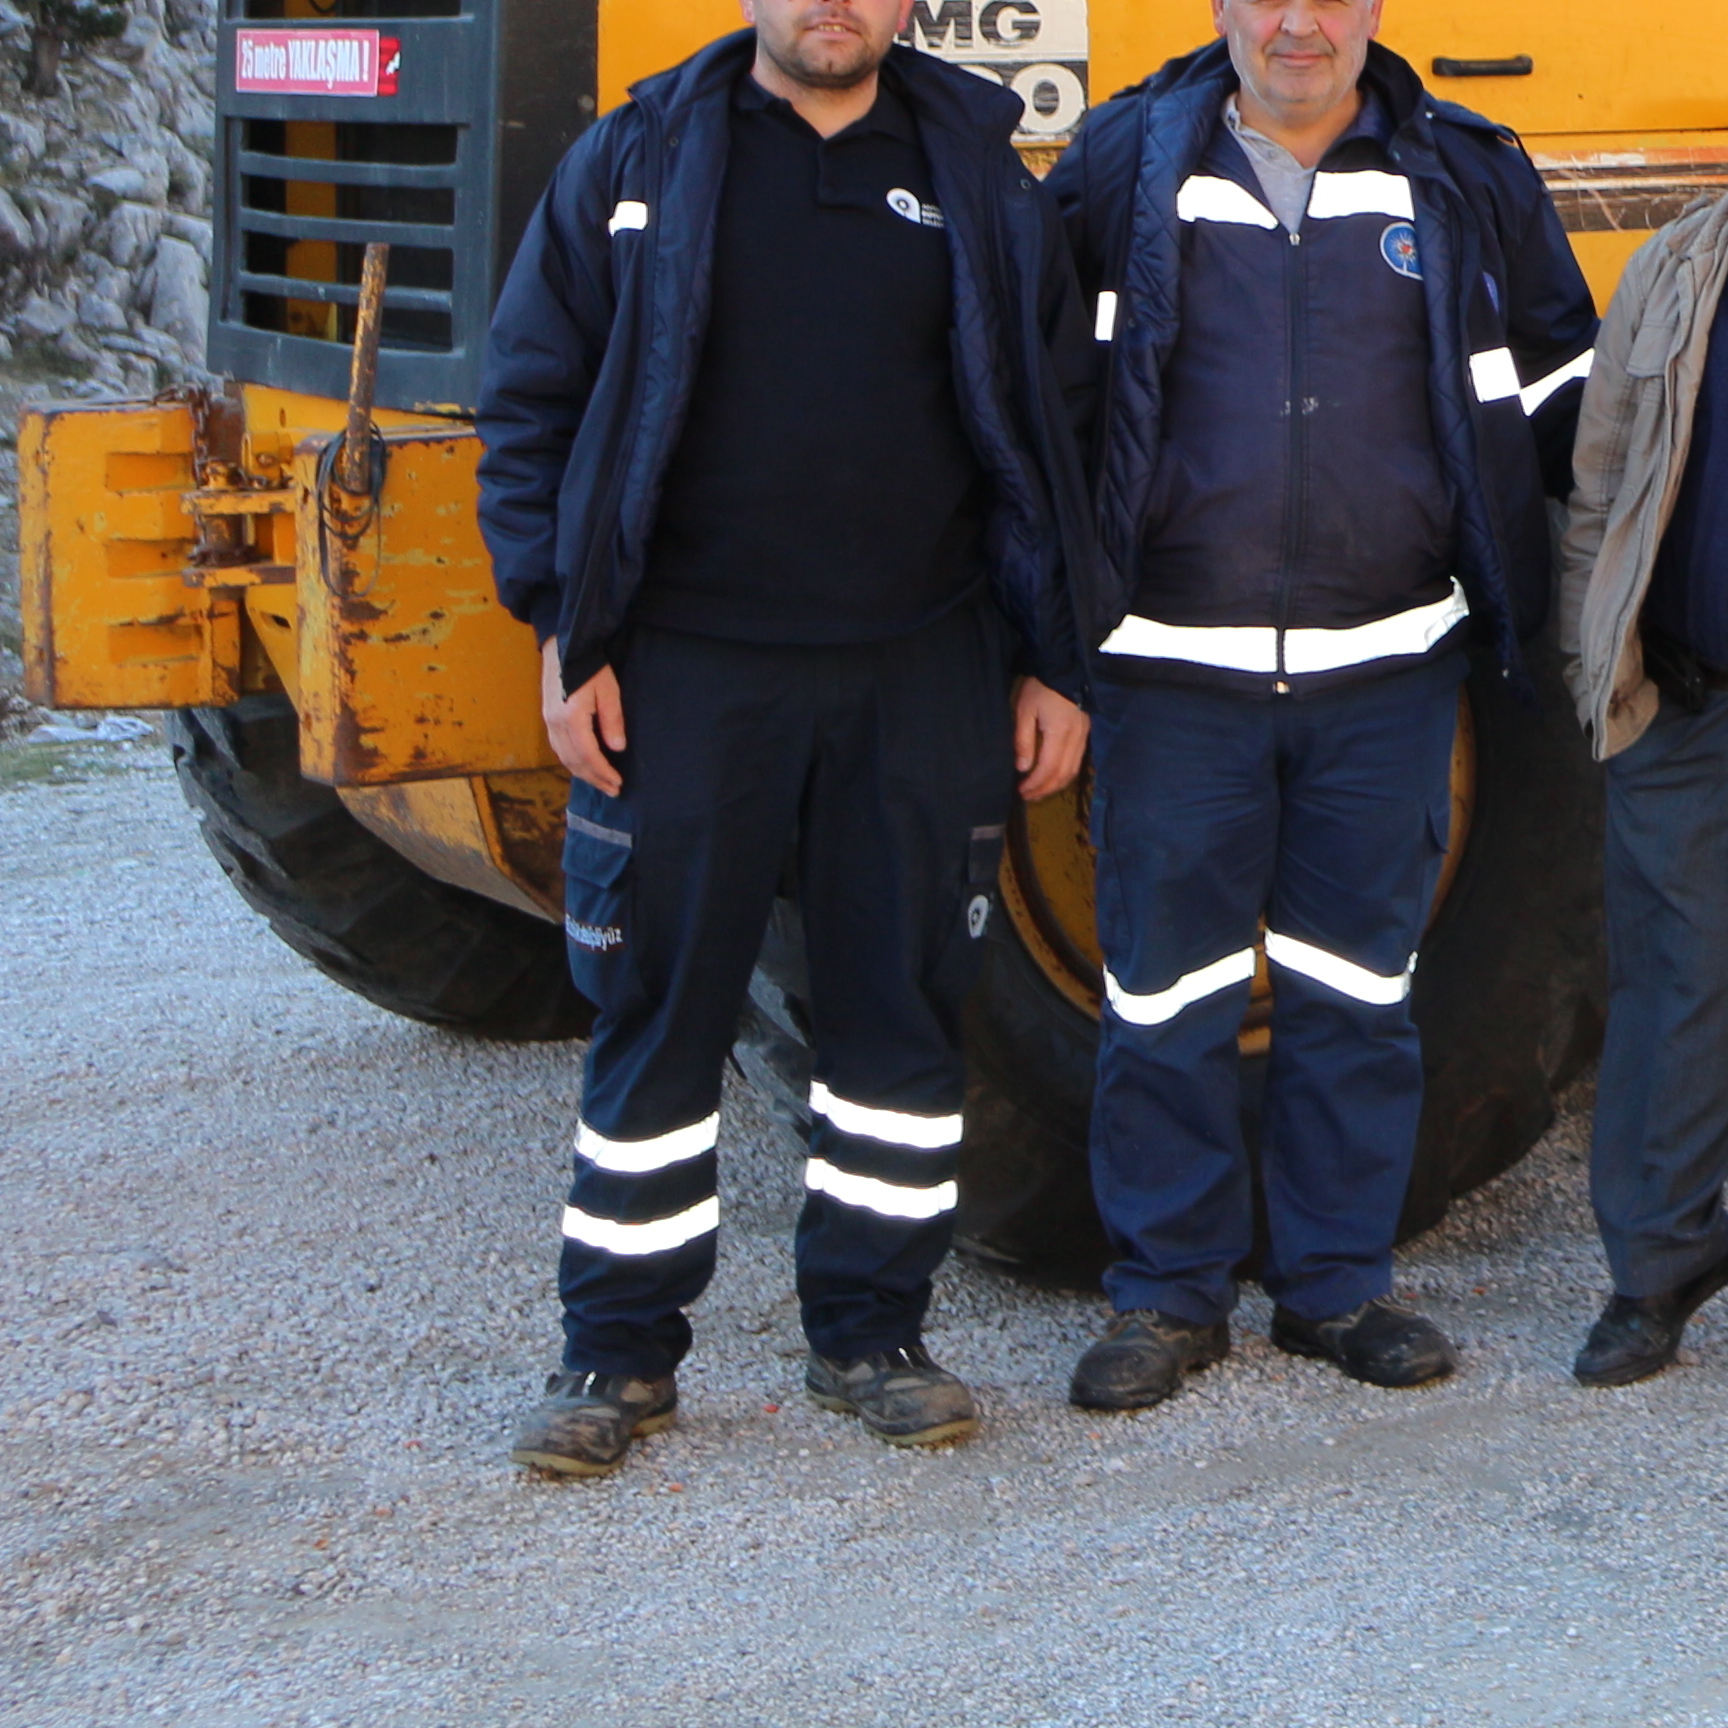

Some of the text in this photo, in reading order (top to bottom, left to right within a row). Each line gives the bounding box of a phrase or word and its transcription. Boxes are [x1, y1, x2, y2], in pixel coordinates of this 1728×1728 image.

[241, 38, 254, 79] 25
[254, 42, 286, 81] metre
[287, 38, 361, 90] YAKLAŞMA
